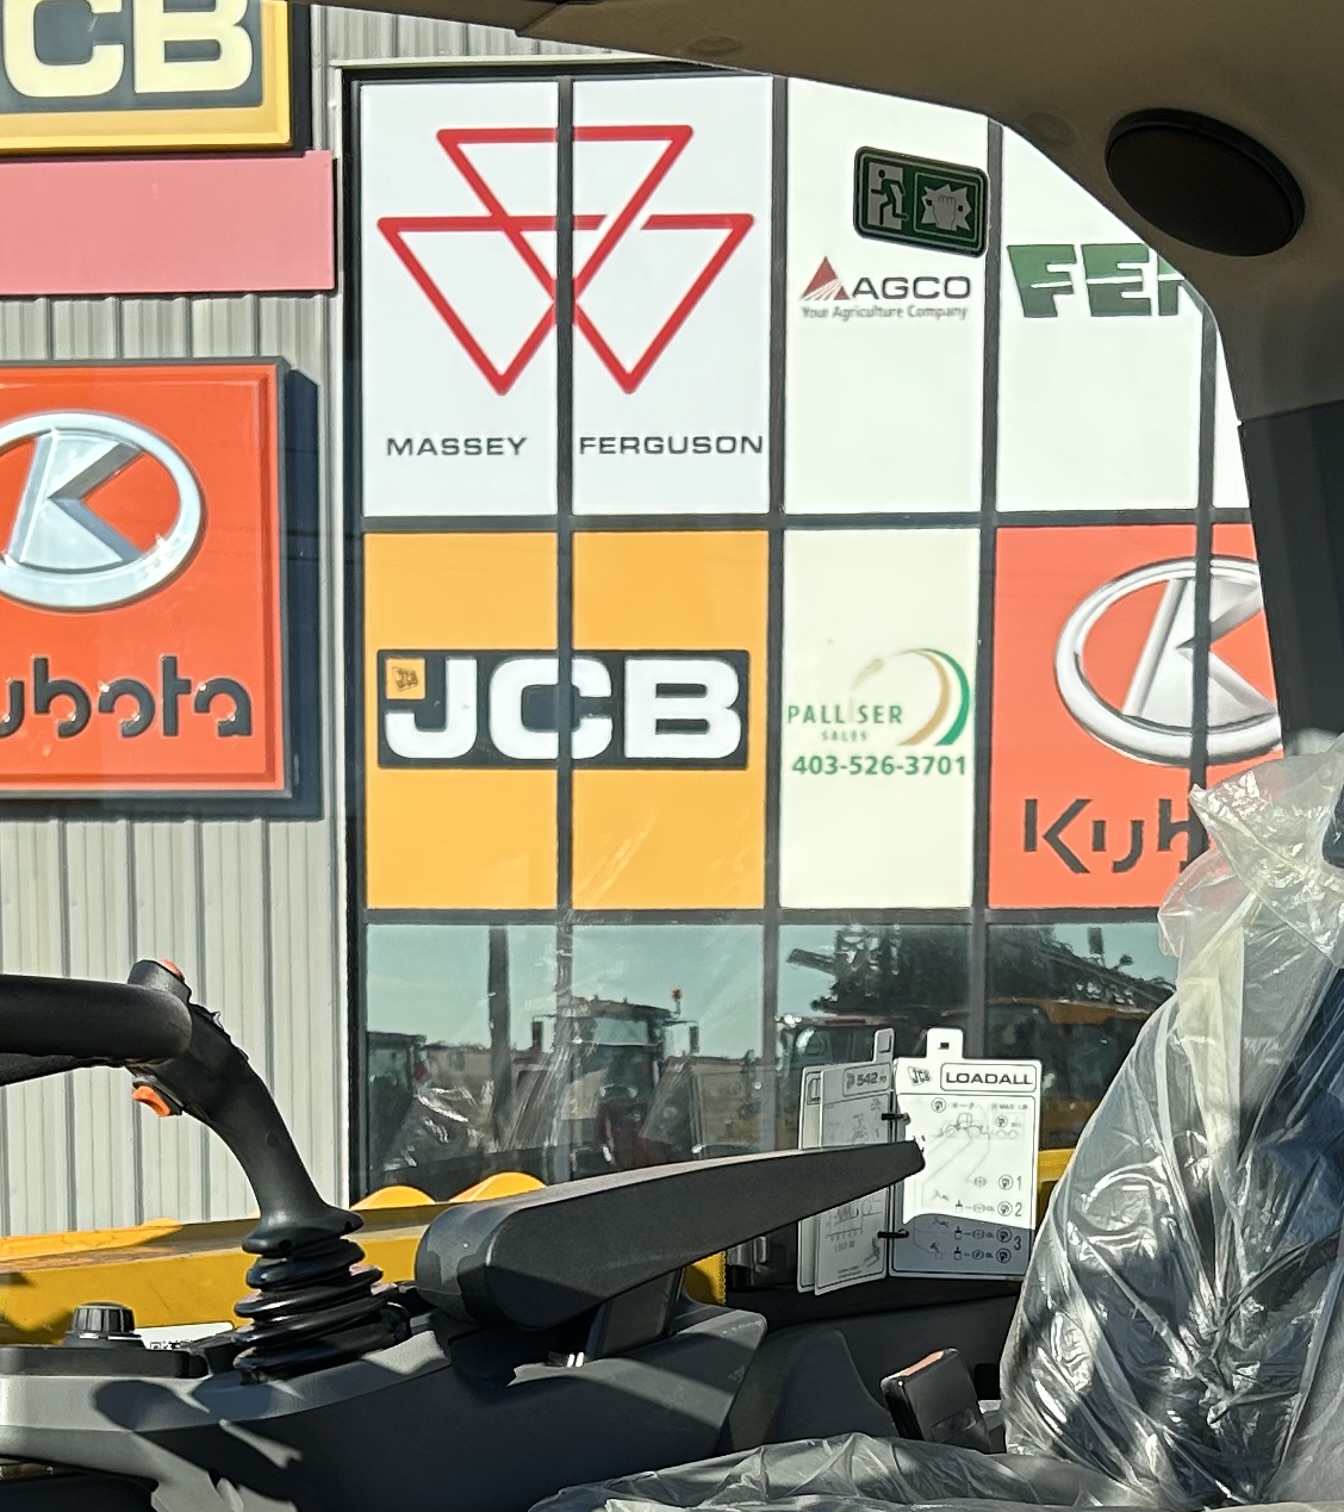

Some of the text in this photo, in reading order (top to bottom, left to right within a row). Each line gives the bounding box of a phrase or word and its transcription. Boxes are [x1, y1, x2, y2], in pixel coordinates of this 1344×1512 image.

[852, 276, 971, 300] AGCO
[800, 303, 968, 322] Your Agriculture Company
[387, 435, 764, 456] MASSEY FERGUSON
[385, 656, 742, 760] JCB
[821, 731, 868, 741] SALES
[792, 756, 965, 775] 403-526-3701
[945, 1071, 1033, 1085] LOADALL
[1014, 1202, 1022, 1217] 2
[1013, 1235, 1022, 1250] 3
